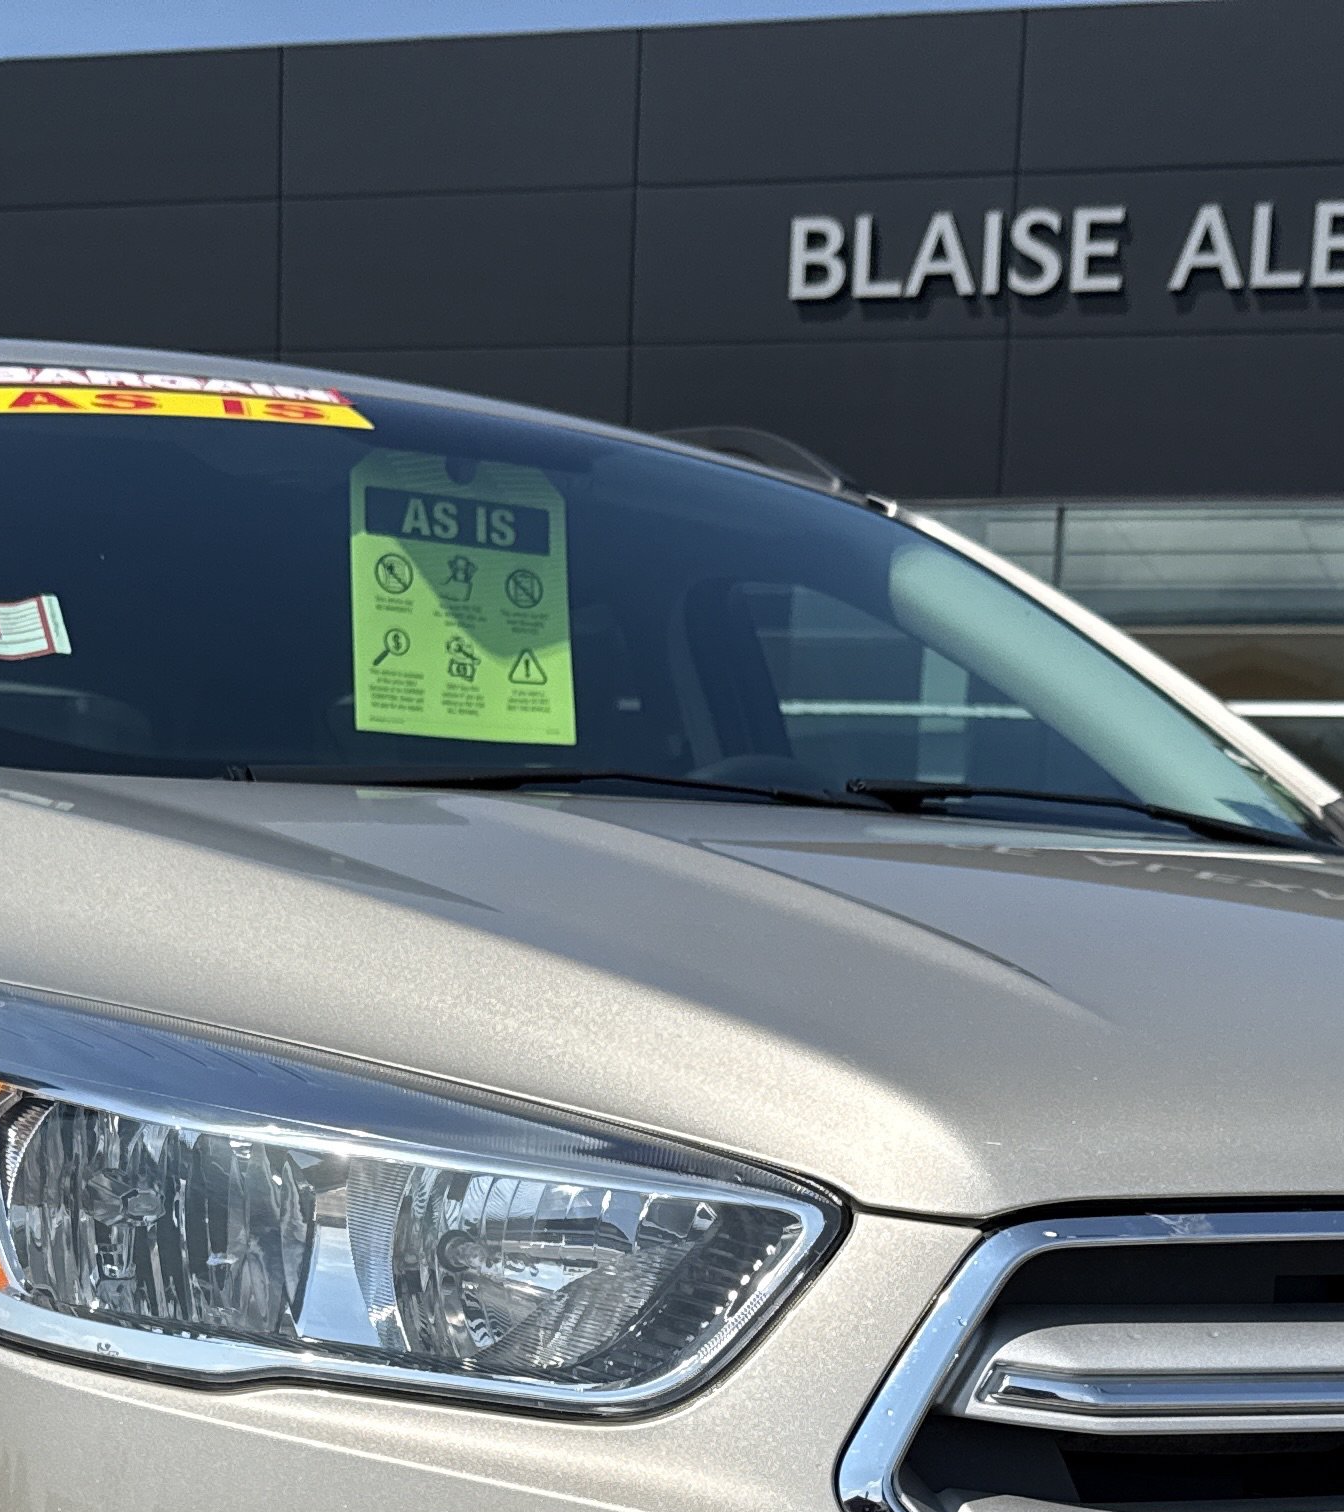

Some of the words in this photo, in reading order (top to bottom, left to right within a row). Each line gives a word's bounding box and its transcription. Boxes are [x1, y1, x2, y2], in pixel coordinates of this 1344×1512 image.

[788, 206, 1126, 301] BLAISE
[8, 391, 162, 411] AS
[222, 398, 329, 421] IS
[401, 498, 460, 540] AS
[475, 505, 517, 547] IS
